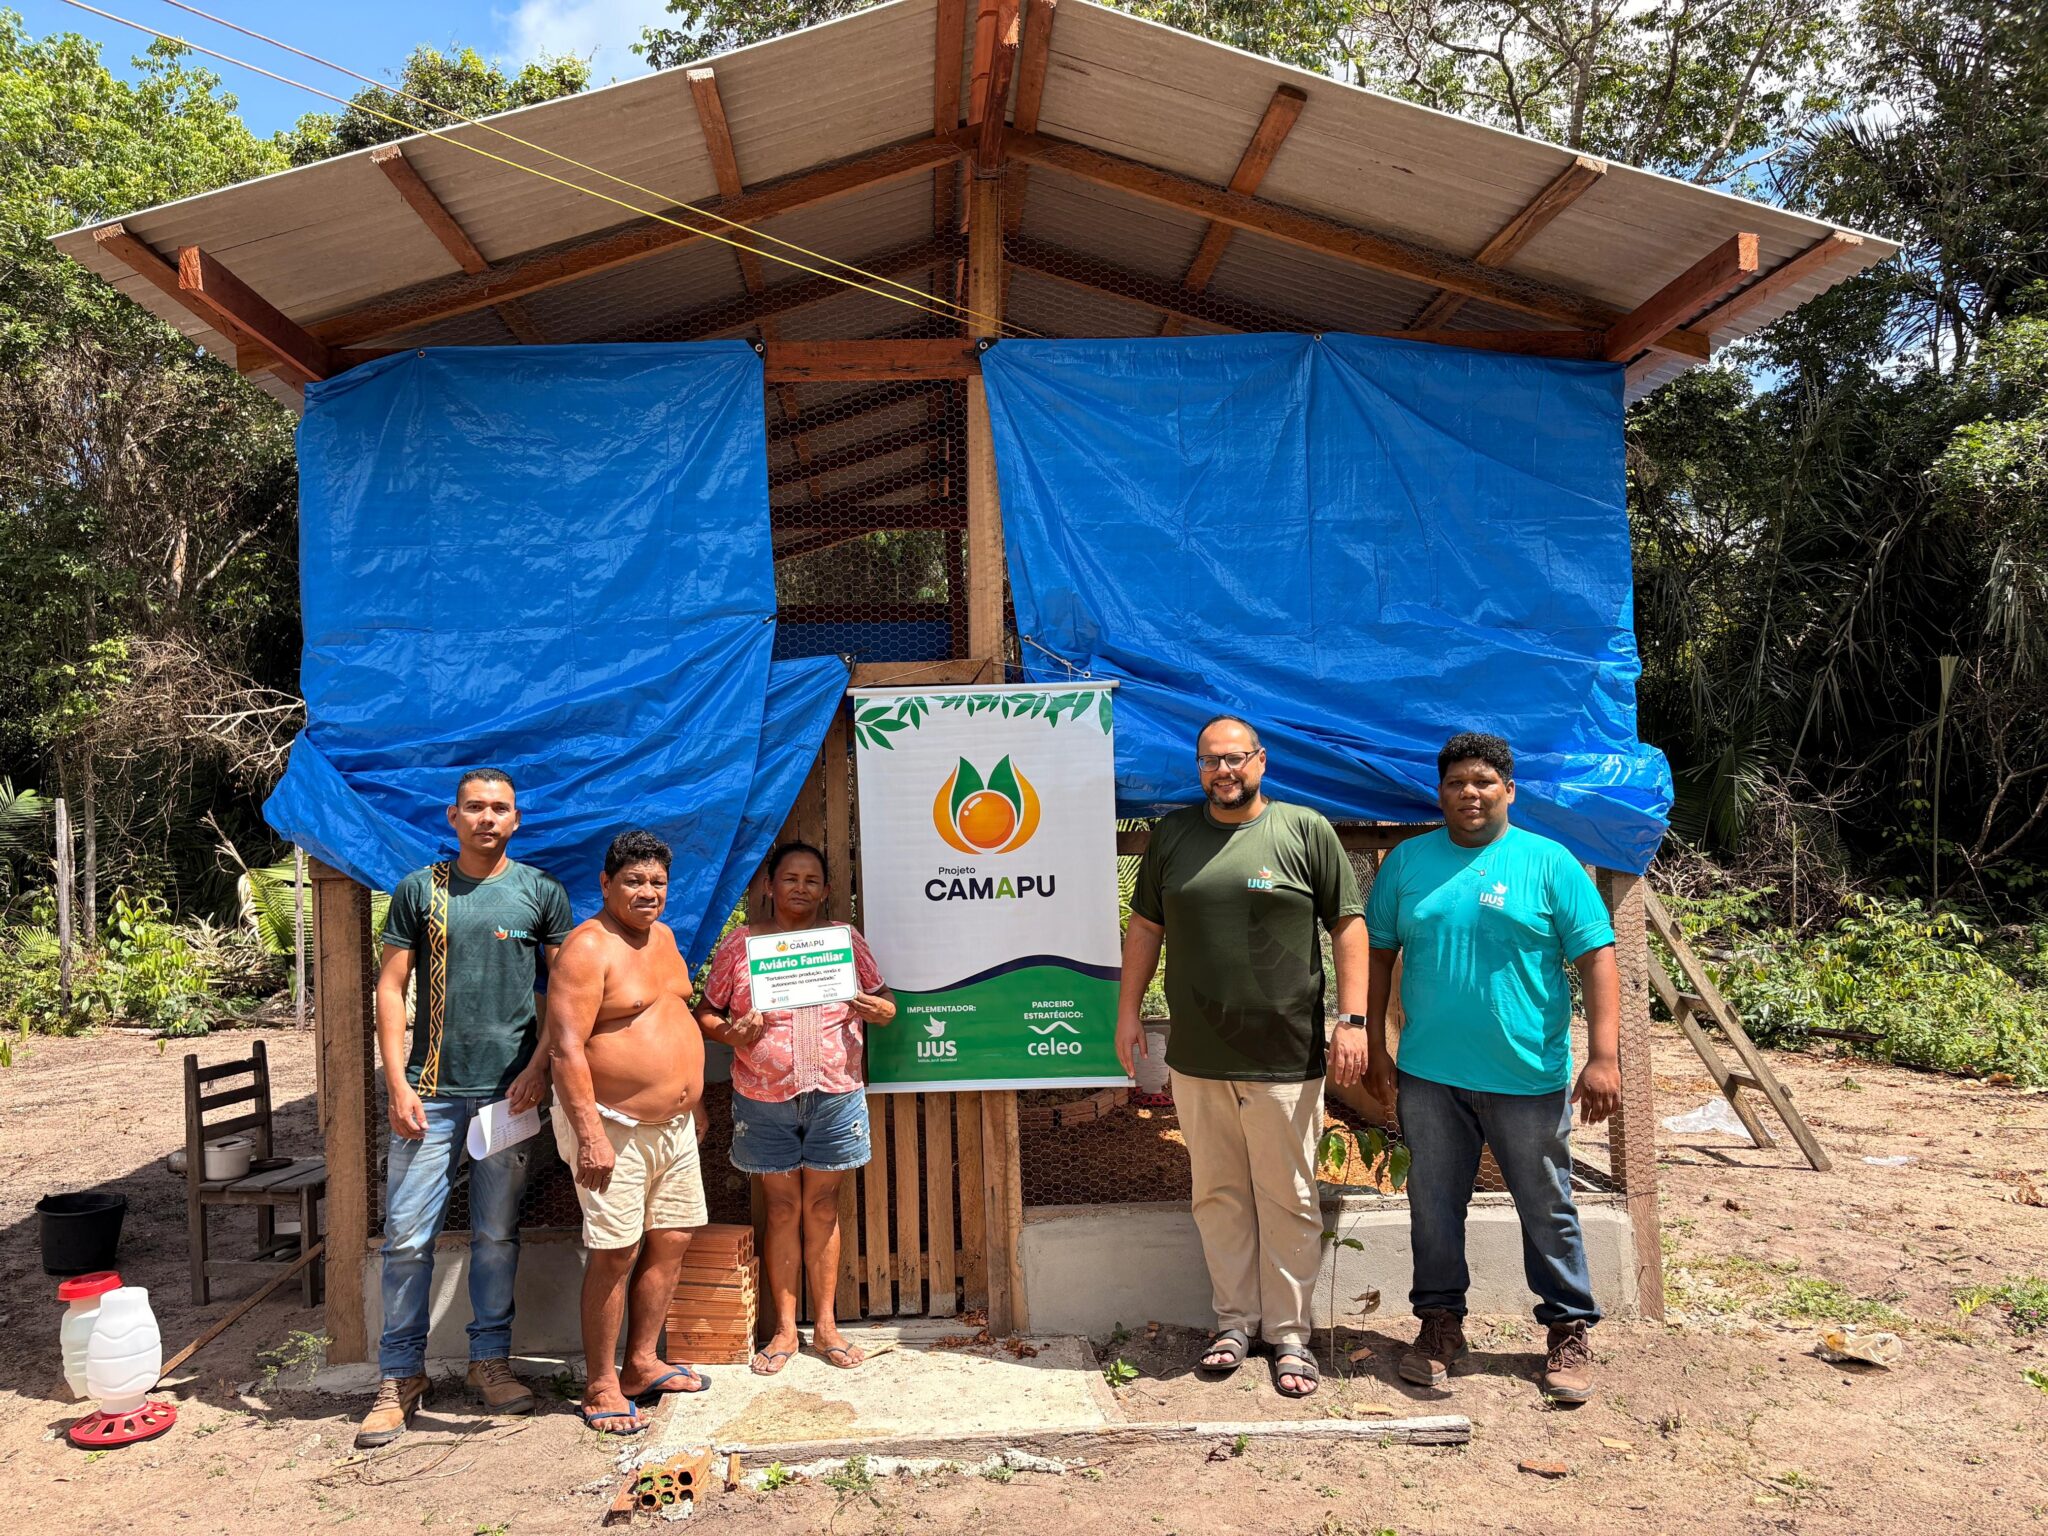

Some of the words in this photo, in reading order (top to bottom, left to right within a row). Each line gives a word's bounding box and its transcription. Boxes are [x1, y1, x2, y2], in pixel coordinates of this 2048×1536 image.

[938, 866, 976, 876] Projeto
[925, 875, 1056, 901] CAMAPU
[1247, 878, 1273, 890] IJUS
[1480, 892, 1505, 907] IJUS
[510, 929, 528, 939] IJUS
[790, 940, 824, 949] CAMAPU
[759, 959, 798, 971] Aviário
[801, 952, 844, 965] Familiar
[906, 1004, 977, 1014] IMPLEMENTADOR:
[1031, 1000, 1075, 1009] PARCEIRO
[1023, 1010, 1084, 1020] ESTRATÉGICO:
[917, 1040, 958, 1058] IJUS
[1027, 1037, 1082, 1056] celeo
